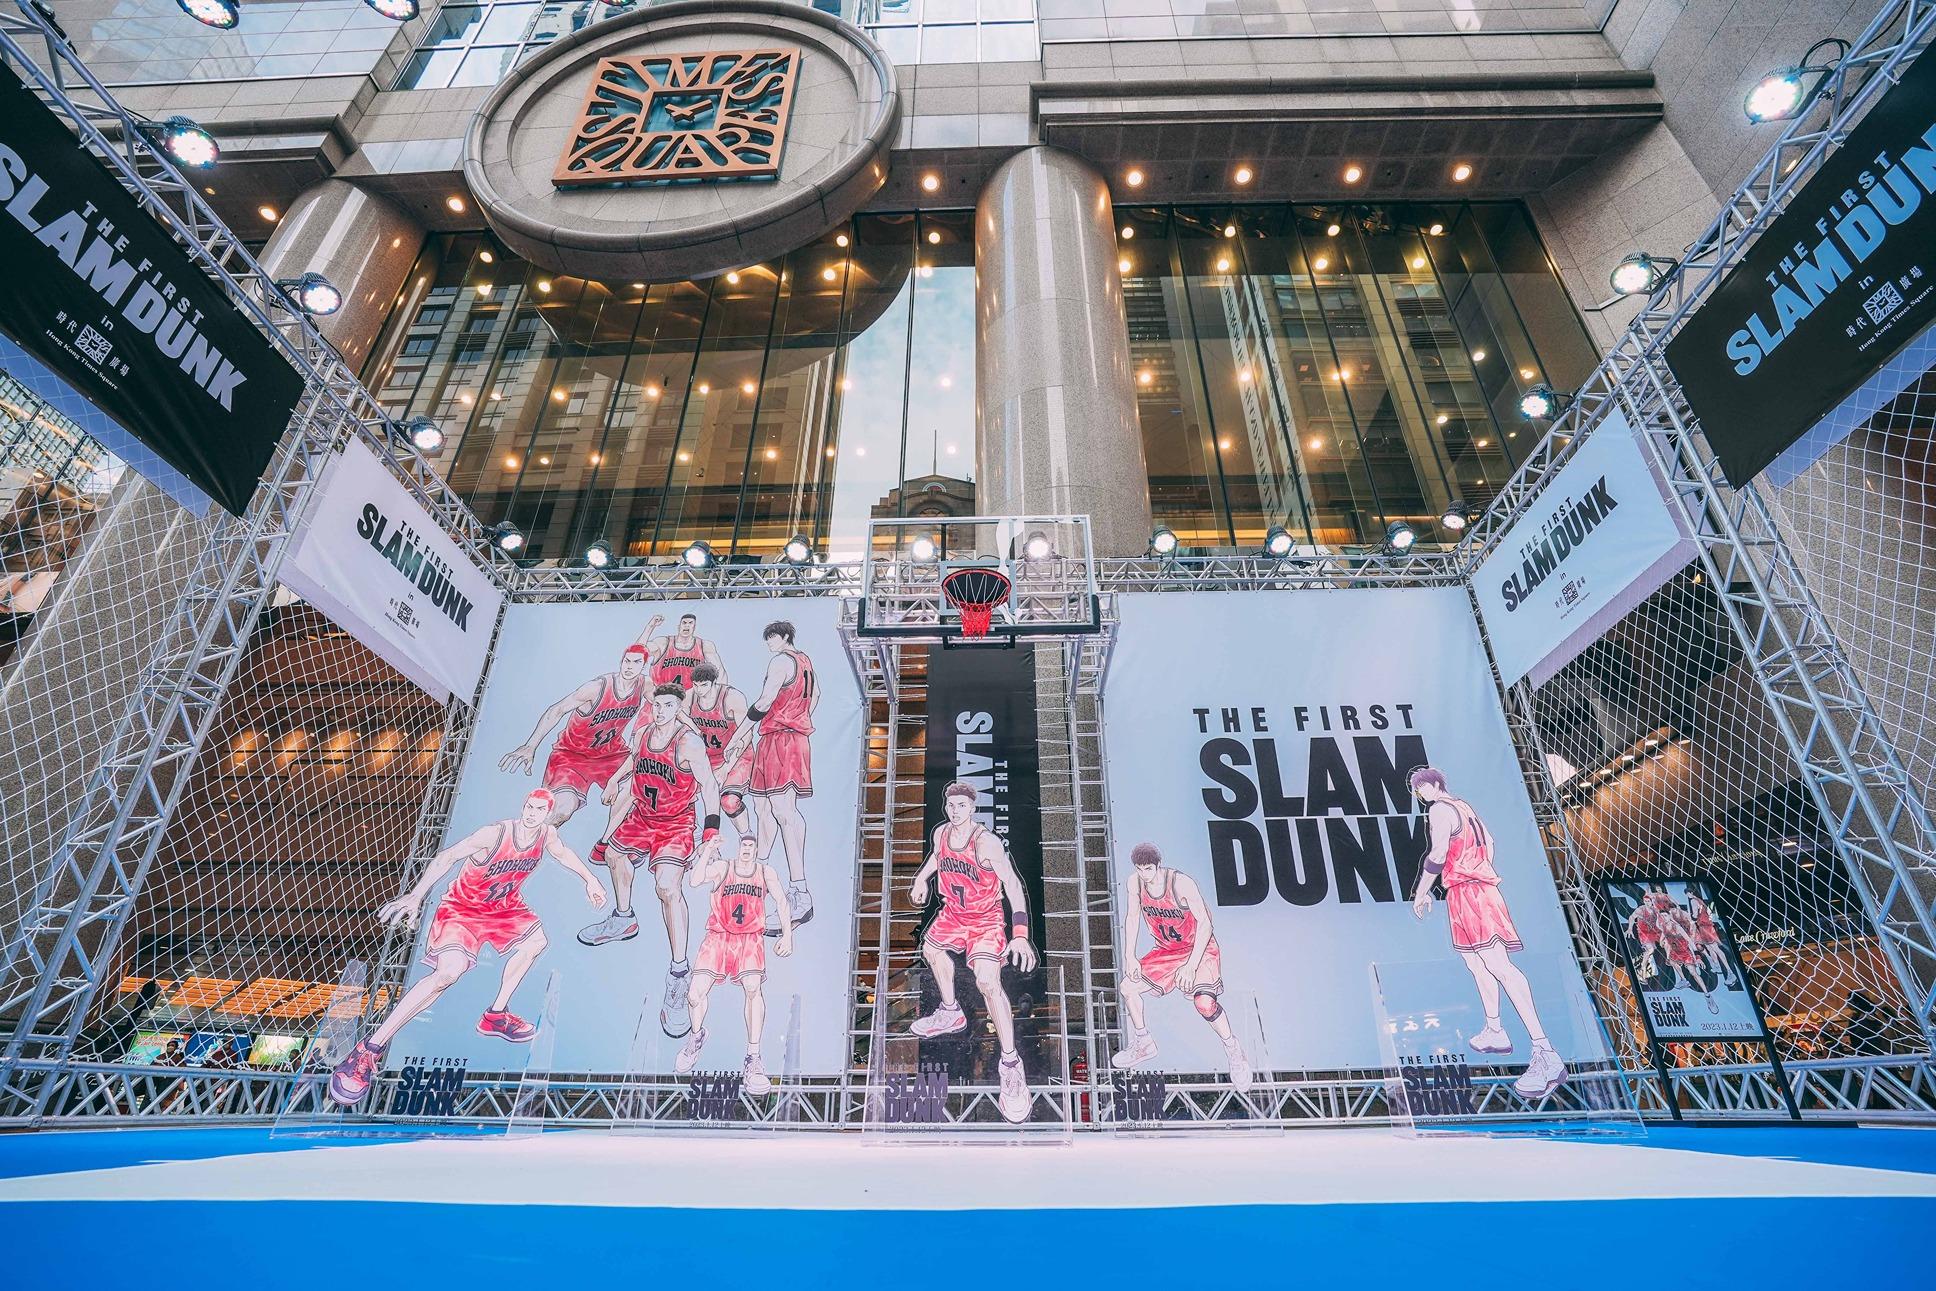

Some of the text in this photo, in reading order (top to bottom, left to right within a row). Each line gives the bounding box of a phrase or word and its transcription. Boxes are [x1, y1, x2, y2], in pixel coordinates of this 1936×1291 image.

[1766, 240, 1809, 288] THE
[1815, 150, 1891, 236] FIRST
[82, 200, 204, 329] THE FIRST
[1858, 275, 1874, 290] in
[1725, 236, 1853, 377] SLAM
[1858, 285, 1934, 352] Hong Kong Times Square
[100, 315, 114, 331] in
[121, 279, 248, 413] DUNK
[46, 329, 63, 347] Hong
[63, 343, 81, 361] Kong
[81, 356, 98, 374] Times
[98, 371, 118, 390] Square
[1519, 497, 1572, 558] THE FIRST
[400, 520, 454, 580] THE FIRST
[1501, 538, 1558, 613] SLAM
[1549, 475, 1619, 563] DUNK
[356, 503, 474, 633] SLAM DUNK
[1192, 704, 1413, 733] THE FIRST
[994, 760, 1008, 793] THE
[644, 784, 658, 812] 7
[722, 883, 763, 898] SHOHOKU
[951, 883, 966, 910] 7
[731, 903, 745, 924] 4
[1158, 925, 1182, 942] 14
[1650, 1002, 1686, 1015] SLAM
[1655, 1014, 1690, 1027] DUNK
[404, 1056, 468, 1067] THE FIRST
[1399, 1054, 1466, 1065] THE FIRST
[398, 1066, 466, 1091] SLAM
[689, 1078, 740, 1099] SLAM
[885, 1072, 949, 1098] SLAM
[1113, 1079, 1166, 1099] SLAM
[1401, 1064, 1473, 1090] SLAM
[390, 1091, 459, 1116] DUNK
[687, 1099, 737, 1120] DUNK
[885, 1098, 948, 1123] DUNK
[1114, 1099, 1167, 1120] DUNK
[1406, 1089, 1479, 1116] DUNK
